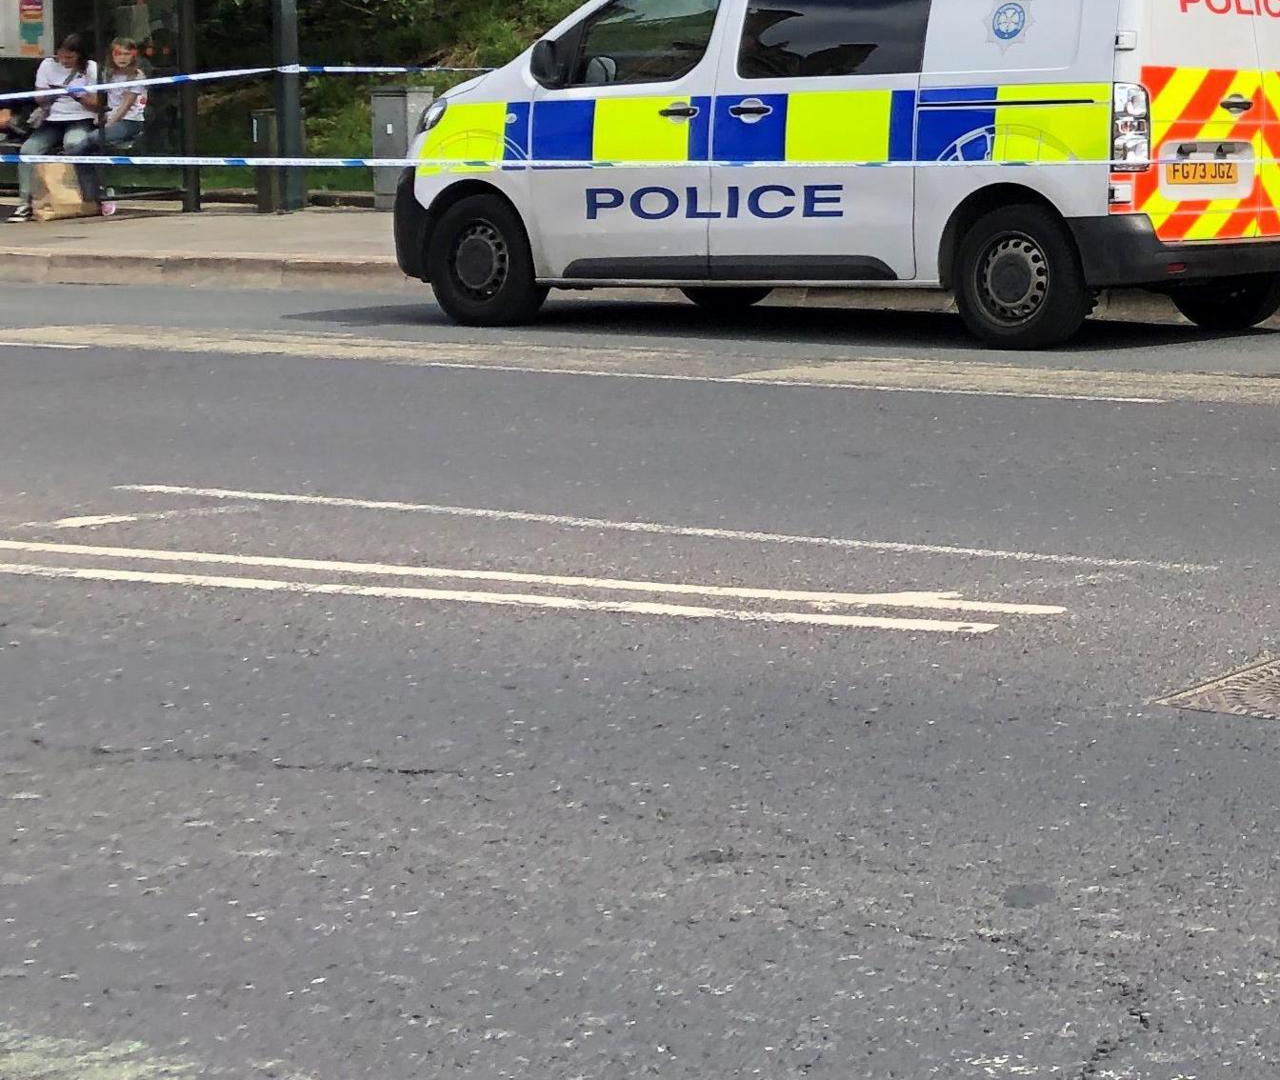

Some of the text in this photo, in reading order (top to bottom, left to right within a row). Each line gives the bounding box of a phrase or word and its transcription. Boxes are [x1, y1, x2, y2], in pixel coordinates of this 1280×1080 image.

[1172, 162, 1233, 180] FG73 JGZ
[585, 184, 844, 220] POLICE
